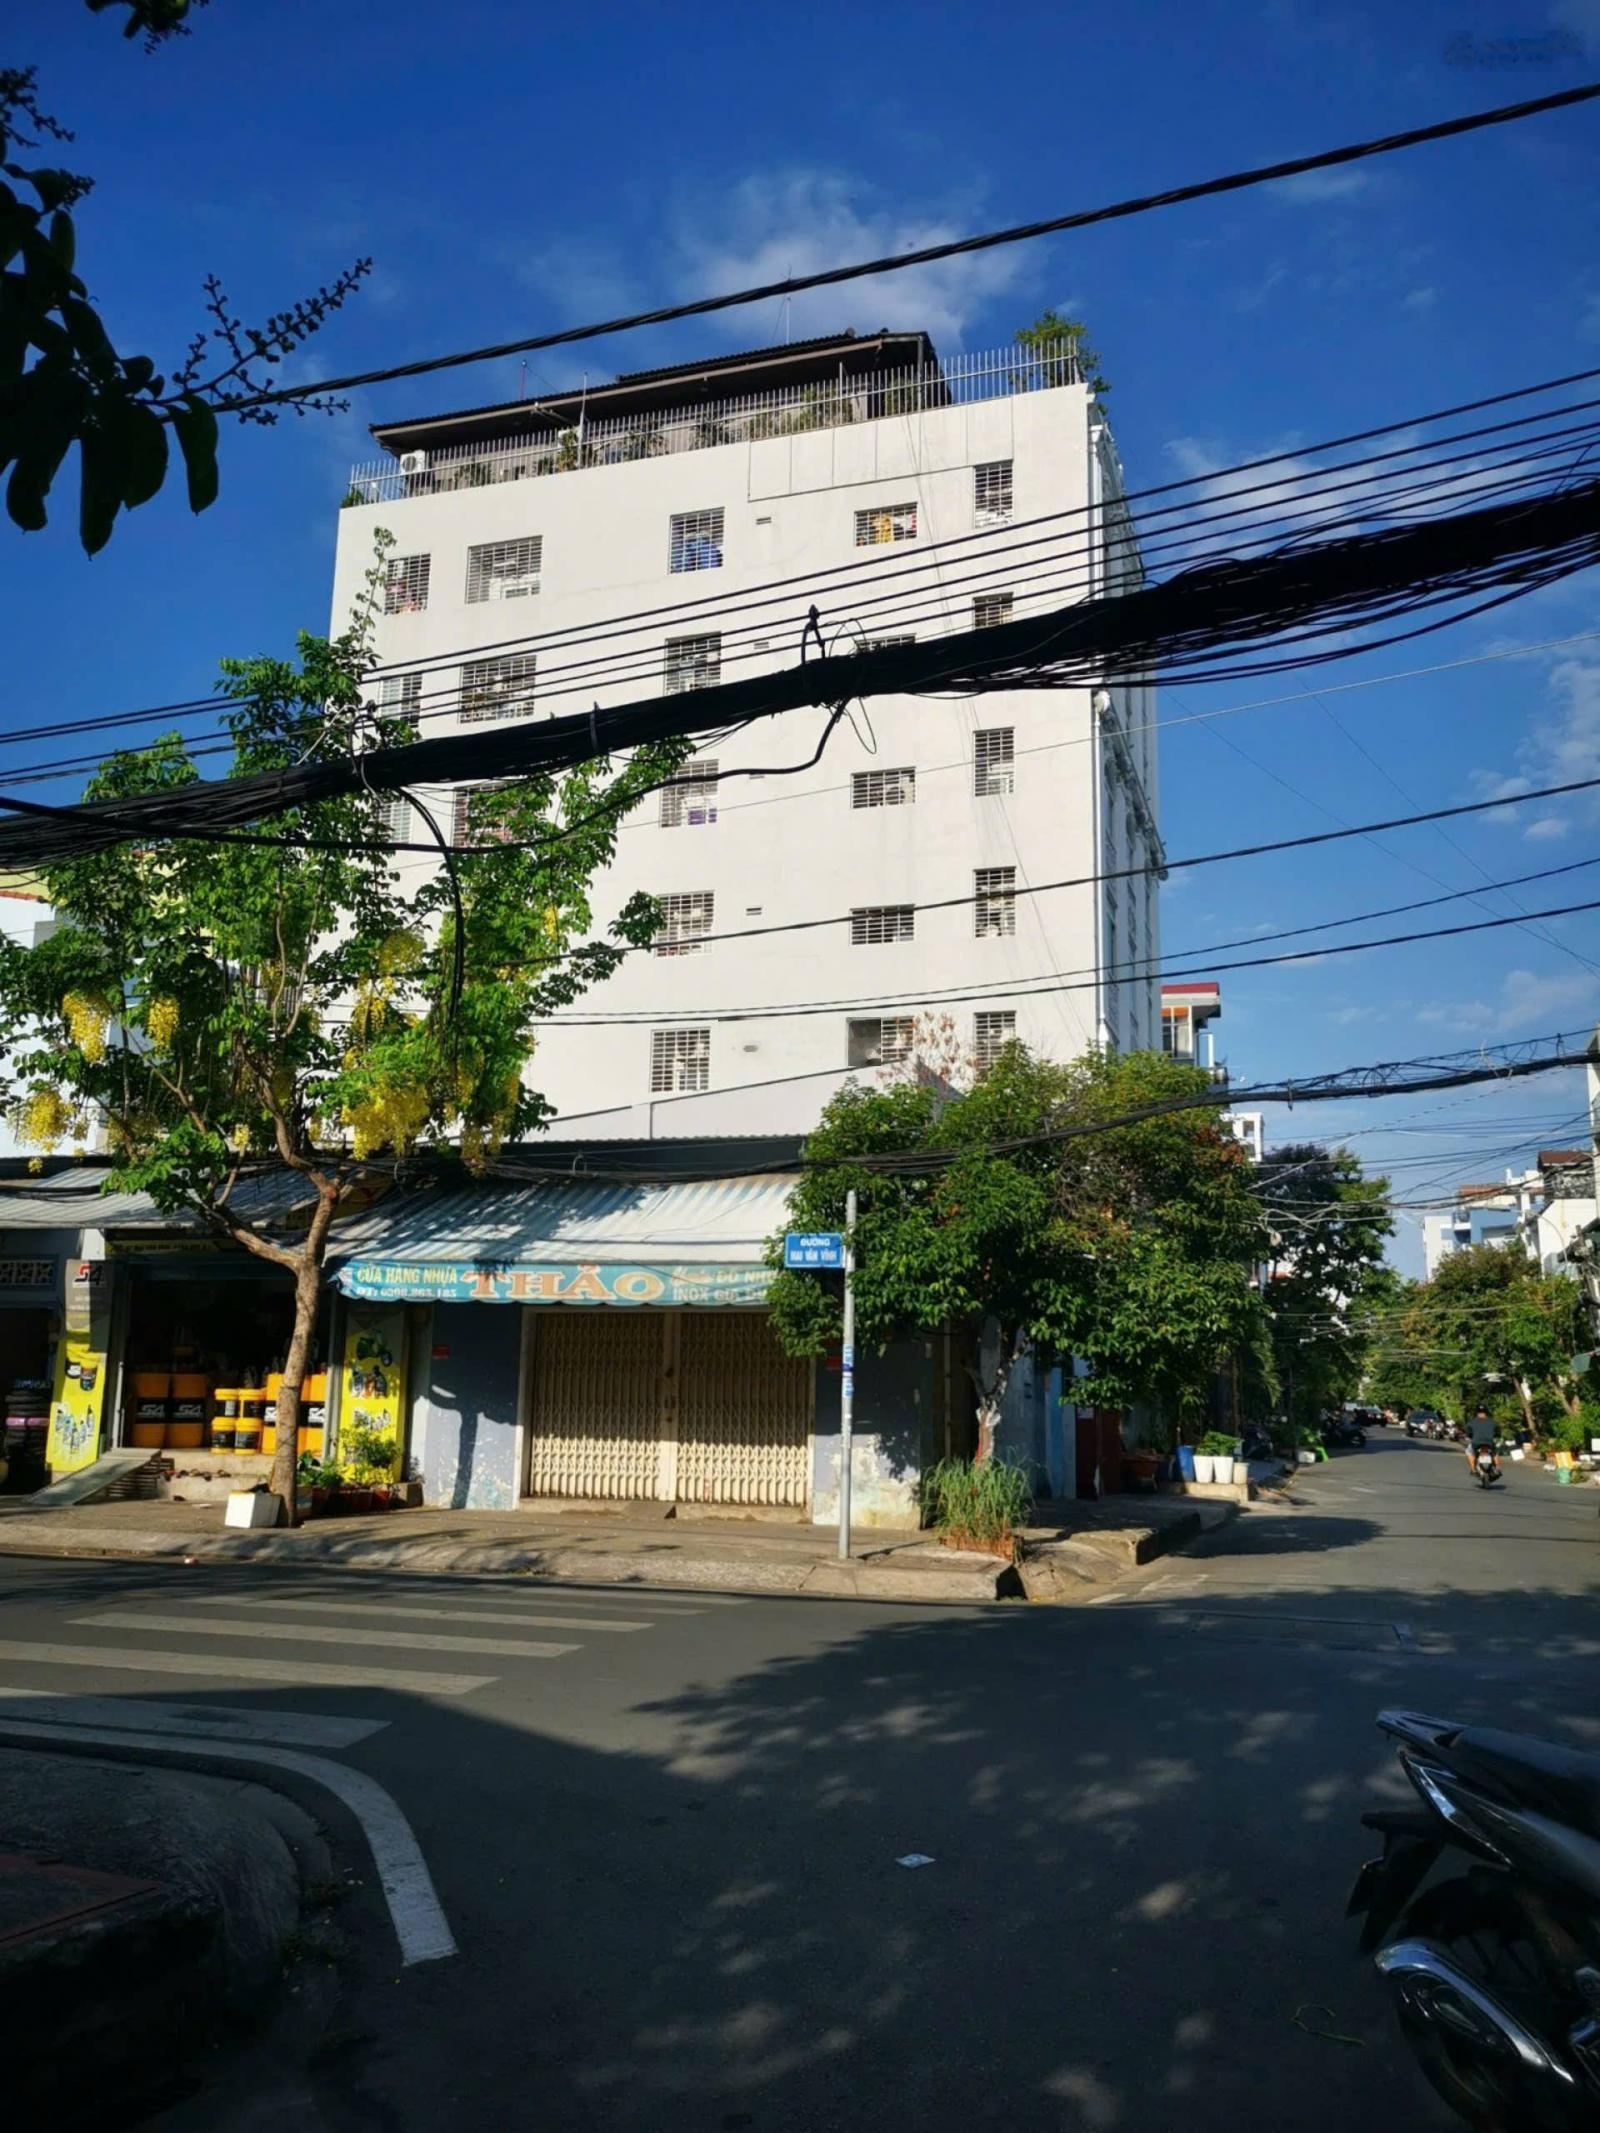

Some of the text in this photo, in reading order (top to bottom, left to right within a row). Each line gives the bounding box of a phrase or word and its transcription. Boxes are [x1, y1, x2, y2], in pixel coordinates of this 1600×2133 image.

[800, 1236, 831, 1247] ĐƯỜNG
[357, 1262, 458, 1287] CỬA HÀNG NHỰA
[460, 1263, 665, 1301] THẢO
[672, 1286, 708, 1301] INOX
